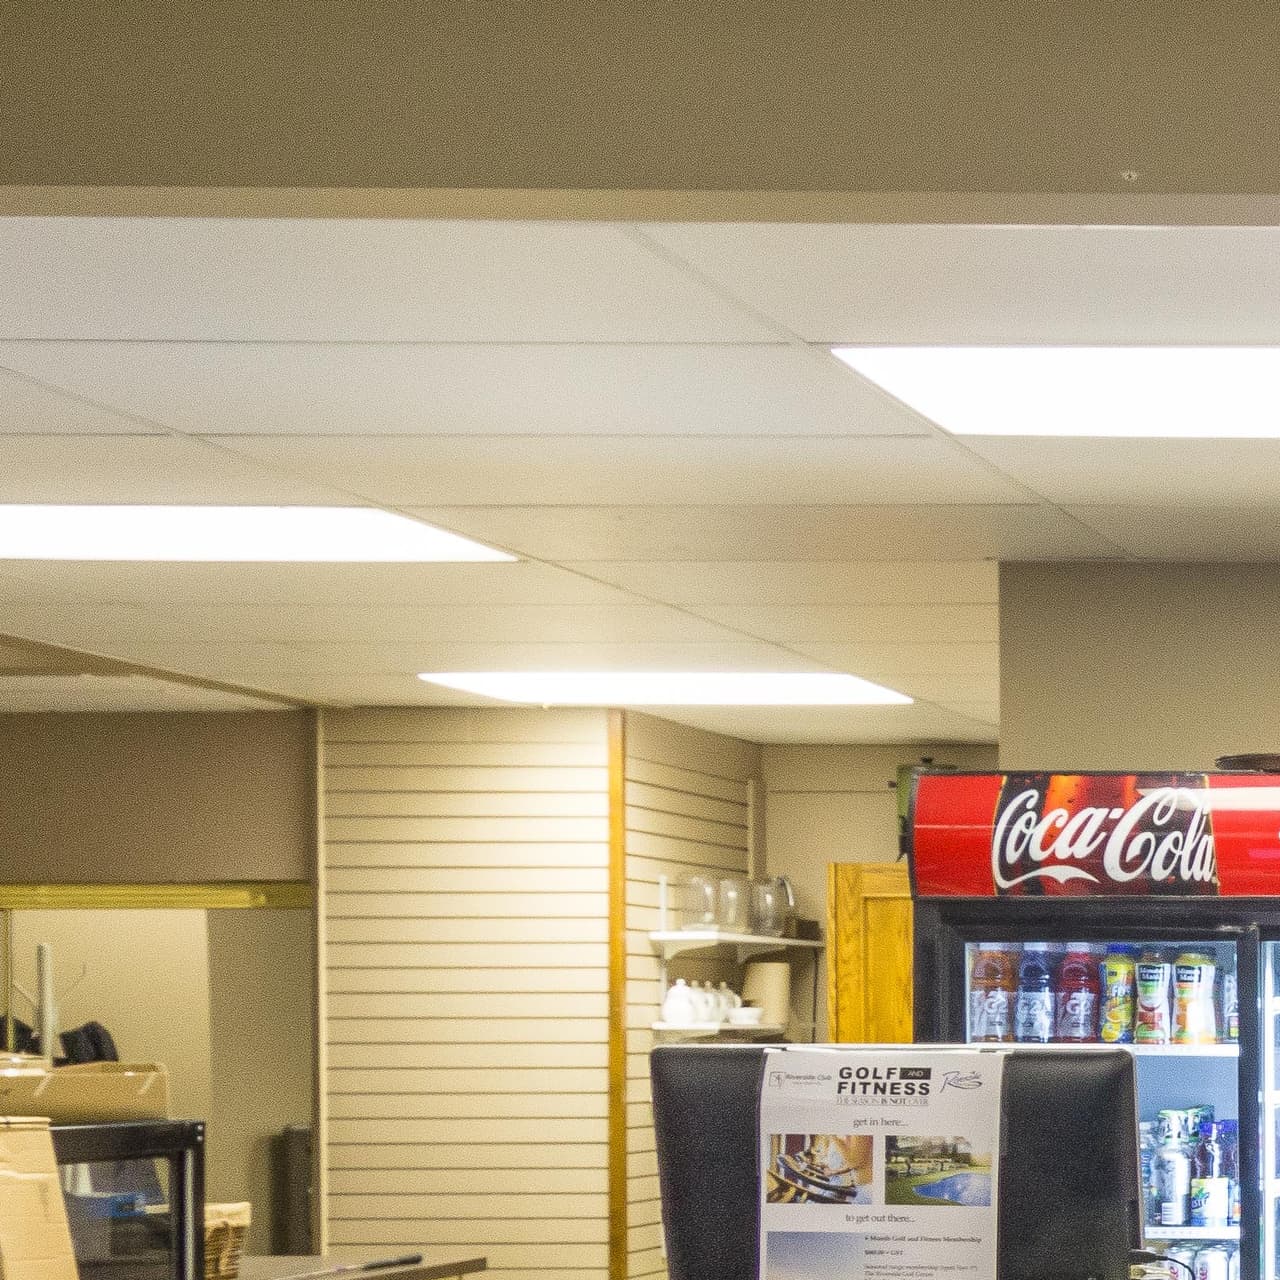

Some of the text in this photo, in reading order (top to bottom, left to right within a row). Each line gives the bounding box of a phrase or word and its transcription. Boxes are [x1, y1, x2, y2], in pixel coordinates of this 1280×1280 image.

[992, 787, 1215, 888] Coca-Cola
[839, 1067, 897, 1080] GOLF
[837, 1082, 930, 1096] FITNESS
[853, 1119, 867, 1128] get
[869, 1118, 879, 1126] in
[846, 1214, 855, 1222] to
[856, 1216, 870, 1225] get
[871, 1215, 886, 1223] out
